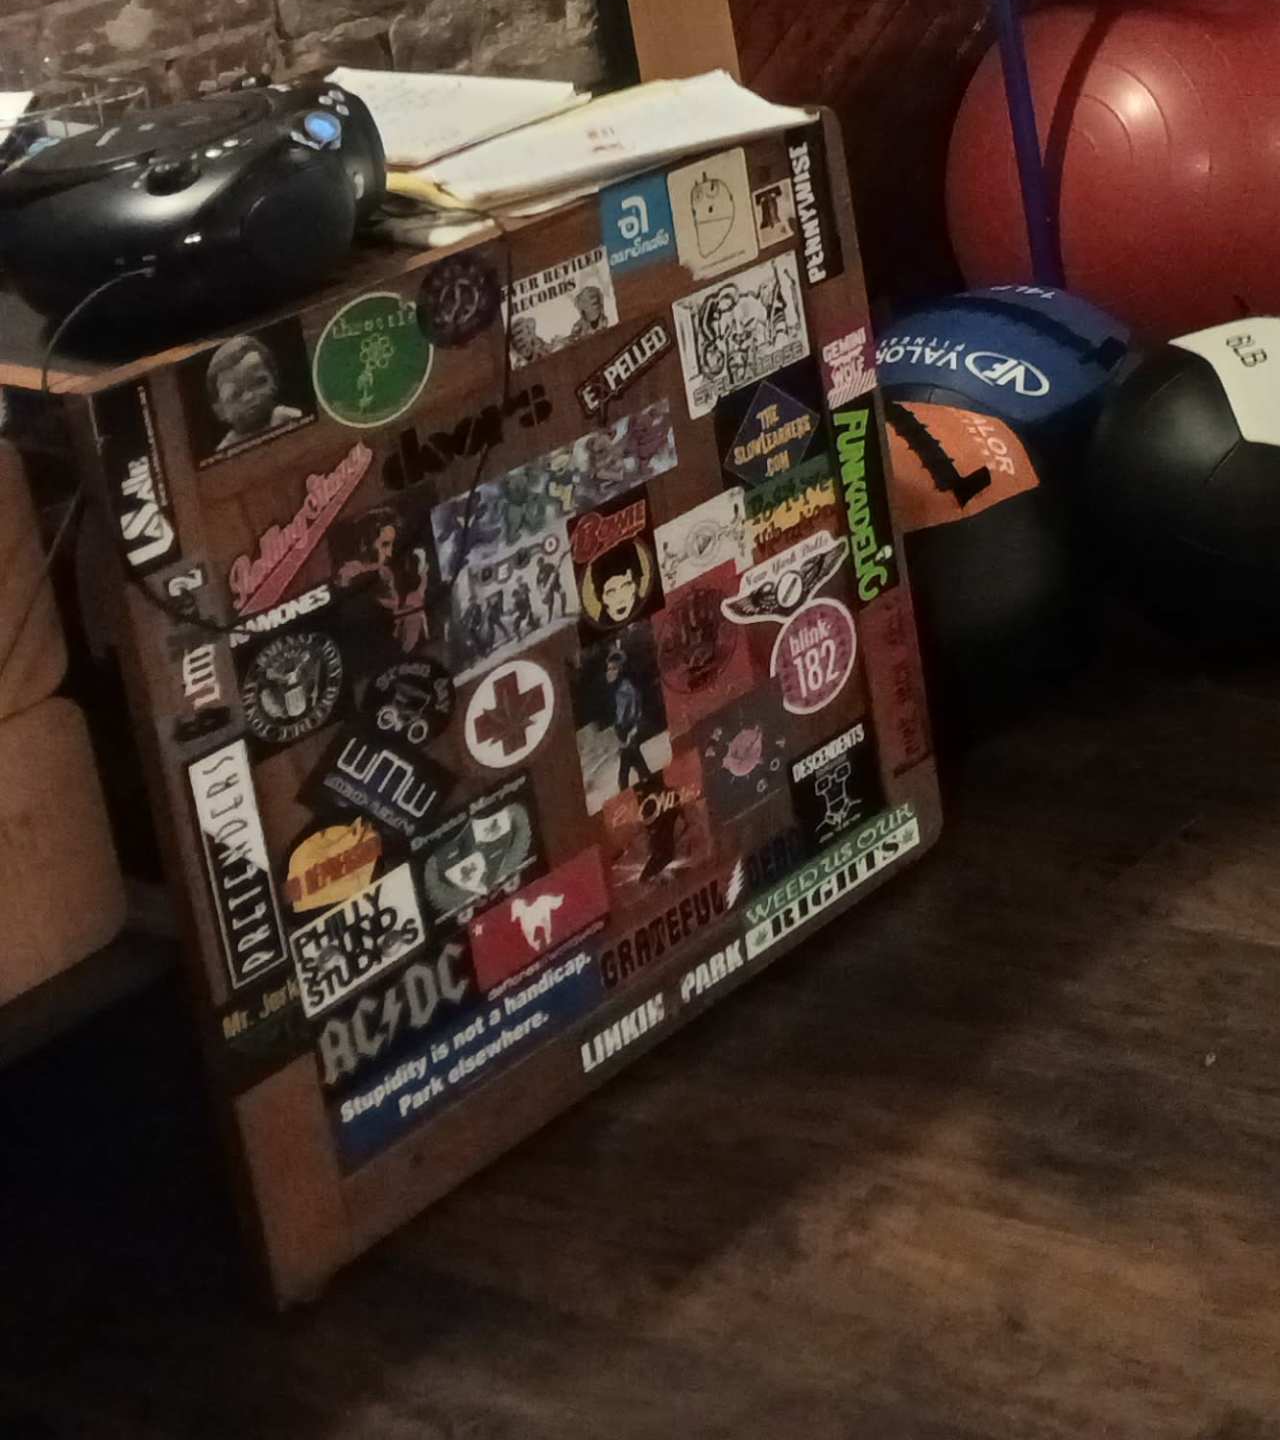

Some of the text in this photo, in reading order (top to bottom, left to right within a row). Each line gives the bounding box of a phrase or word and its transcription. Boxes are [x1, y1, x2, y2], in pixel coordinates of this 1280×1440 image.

[788, 141, 827, 283] PENNYWISE
[509, 278, 577, 315] RECORDS
[542, 248, 604, 285] REVILED
[830, 356, 865, 390] WOLF
[1225, 334, 1268, 368] 6LB
[755, 402, 780, 427] THE
[791, 638, 840, 700] 182
[746, 867, 818, 924] WEED
[857, 801, 915, 849] OUR
[770, 839, 902, 940] RIGHTS
[296, 884, 384, 950] PHILLY
[601, 878, 728, 990] GRATEFUL
[340, 951, 592, 1124] Stupidity is not a handicap.
[580, 991, 666, 1074] LINKIN
[680, 939, 746, 1005] PARK
[397, 1010, 550, 1118] Park elsewhere.
